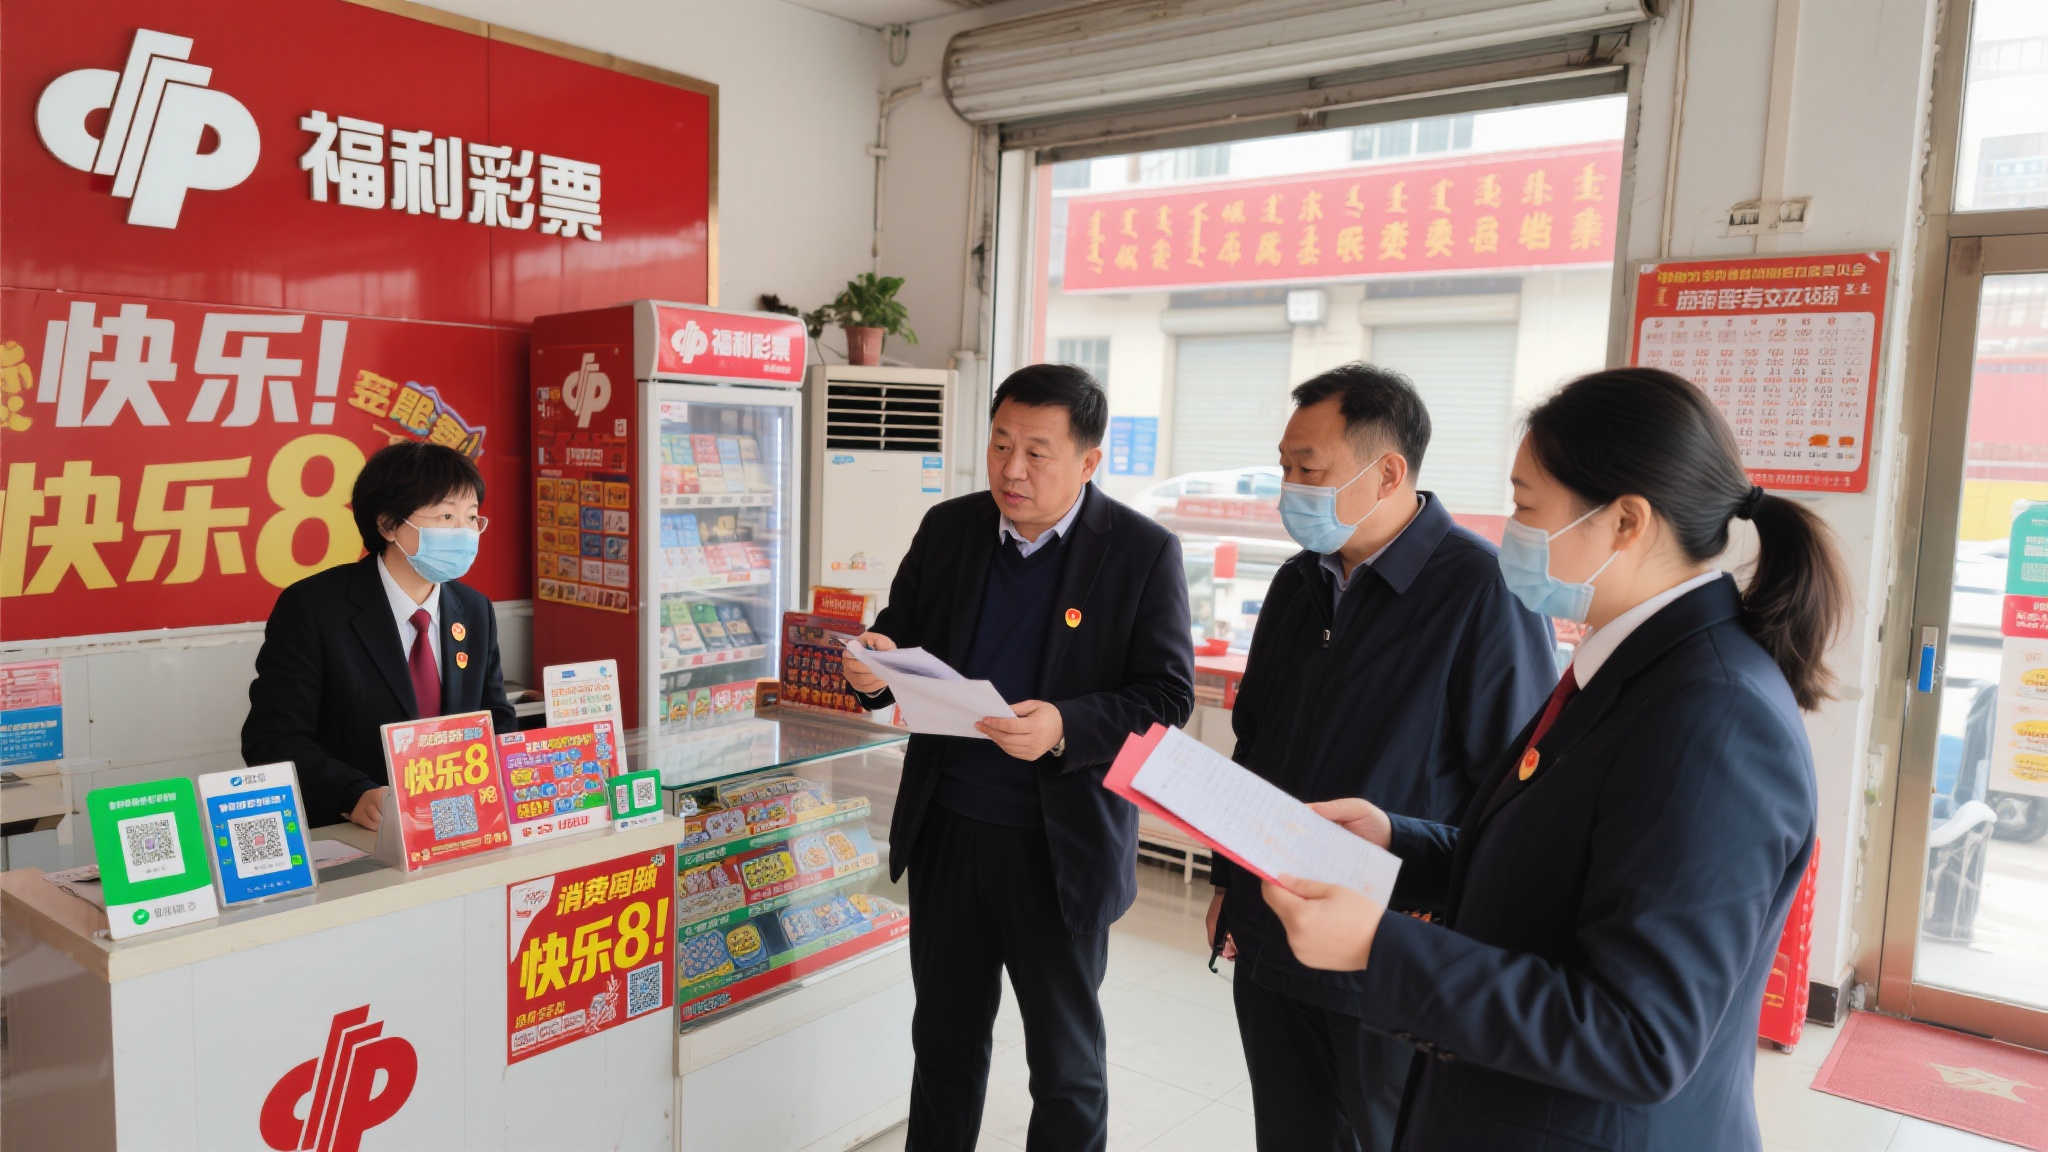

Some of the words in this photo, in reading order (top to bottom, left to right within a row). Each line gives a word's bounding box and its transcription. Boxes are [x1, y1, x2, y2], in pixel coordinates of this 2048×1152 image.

[299, 109, 602, 241] 福利彩票
[404, 743, 490, 797] 快乐8
